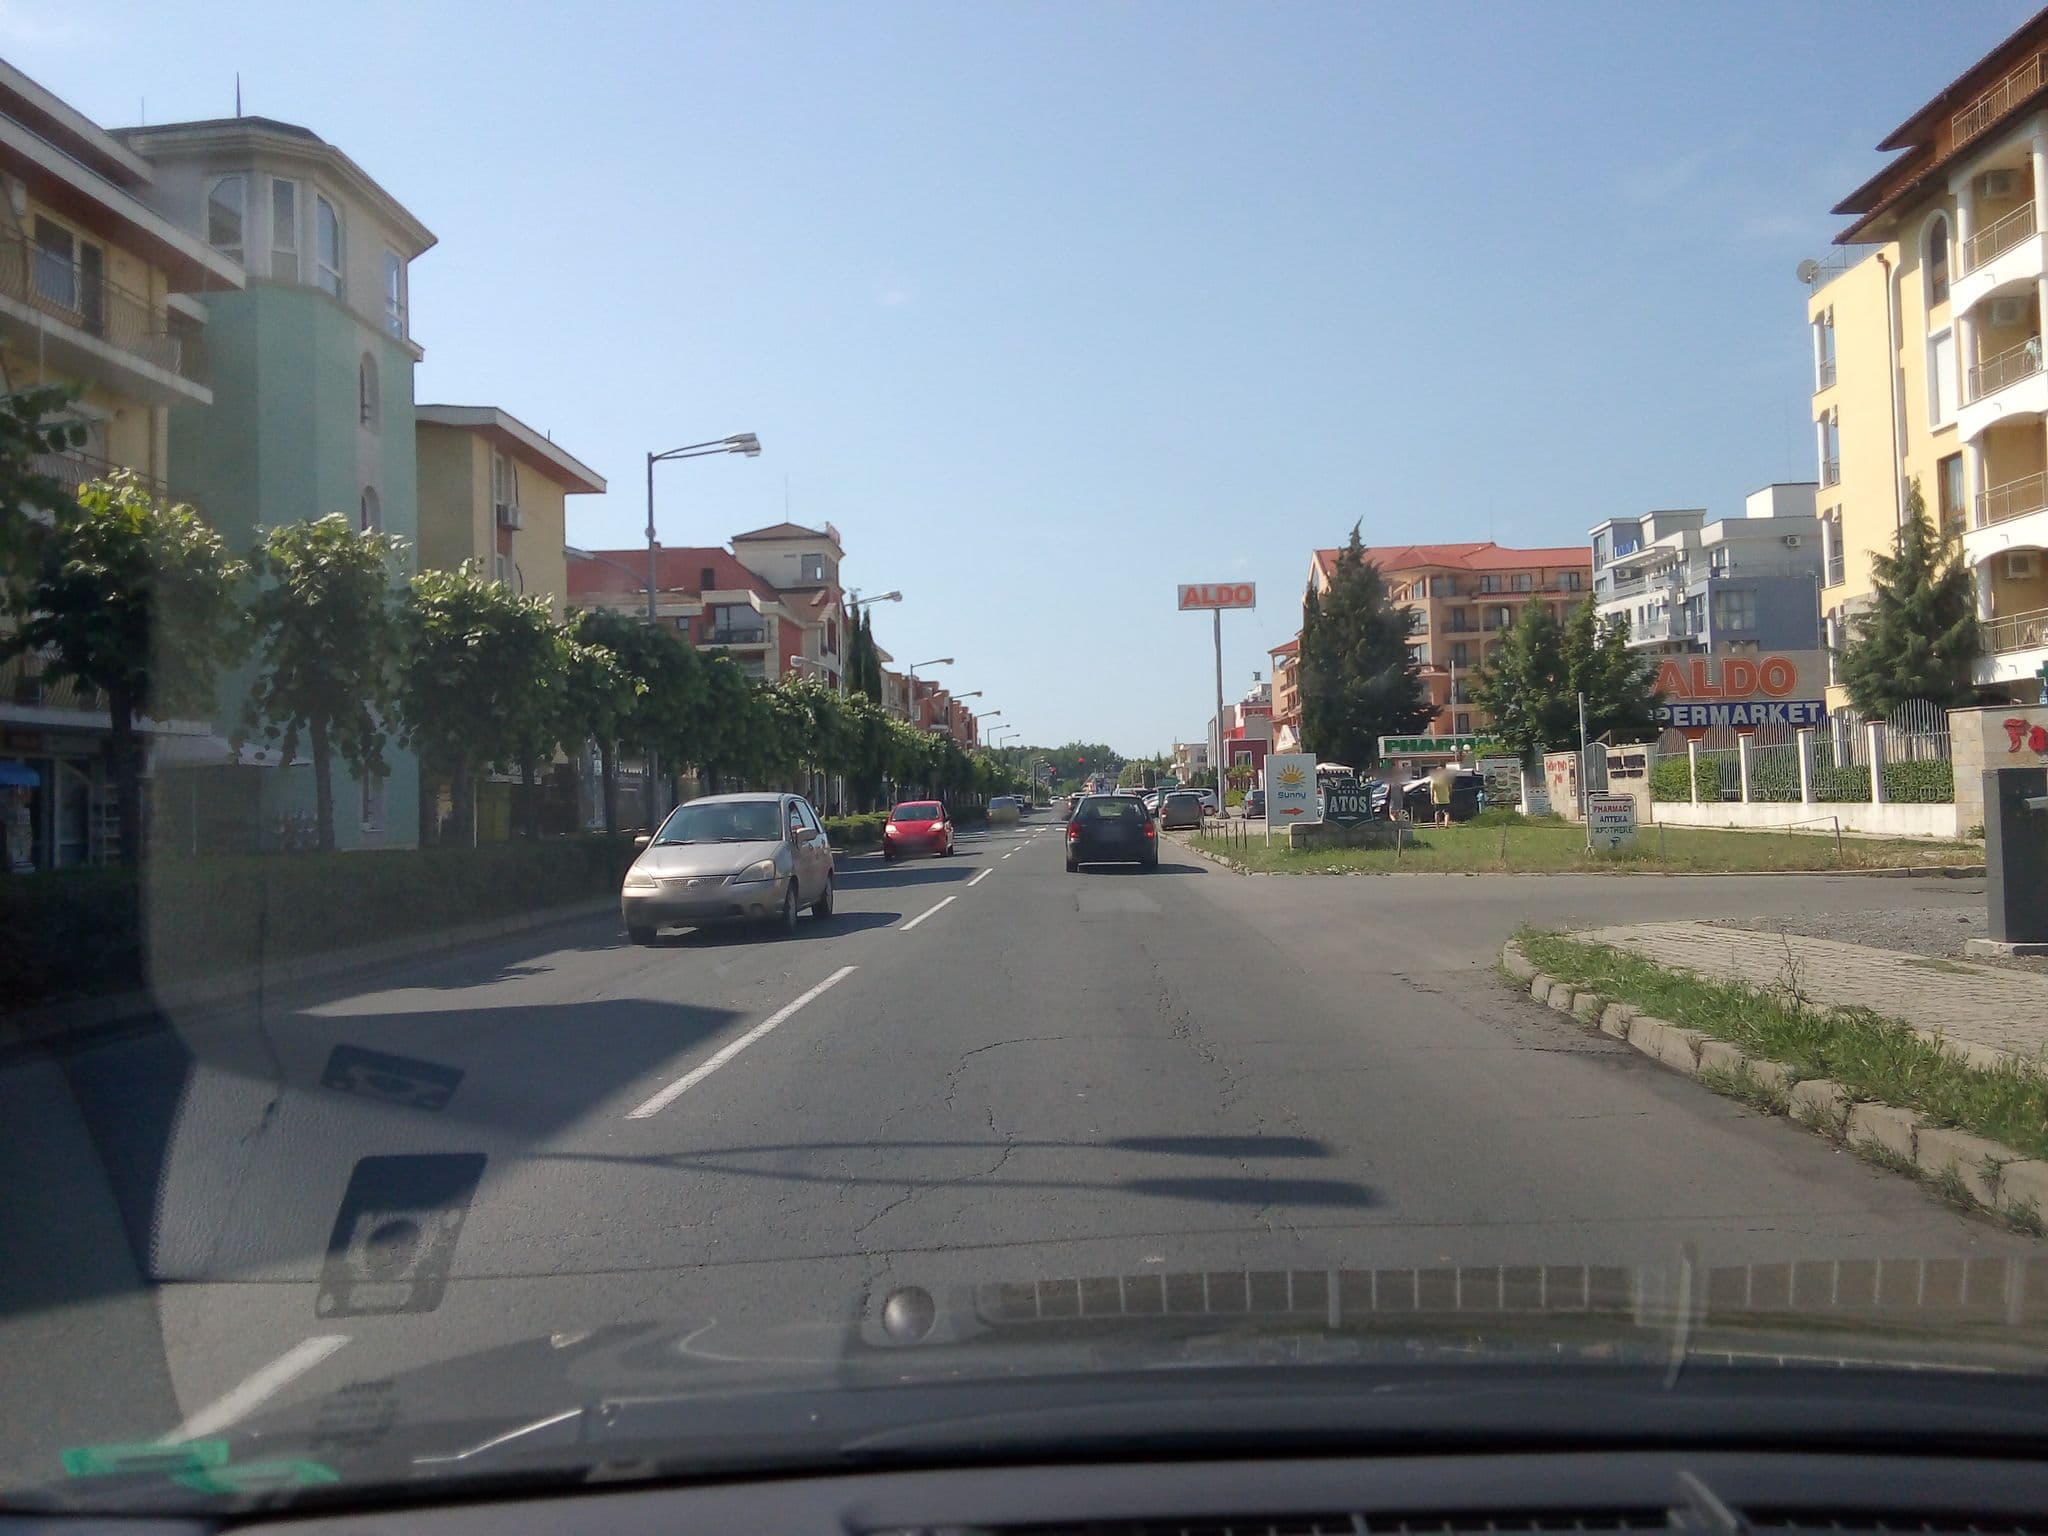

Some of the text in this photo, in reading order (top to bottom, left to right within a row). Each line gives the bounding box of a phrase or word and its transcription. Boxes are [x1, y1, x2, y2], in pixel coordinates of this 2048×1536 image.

[1183, 585, 1253, 607] ALDO
[1653, 656, 1797, 699] ALDO
[1648, 703, 1821, 727] PERMARKET
[1278, 791, 1306, 800] Sunny
[1329, 796, 1368, 814] ATOS
[1593, 804, 1633, 813] PHARMACY
[1599, 815, 1628, 823] АПТЕКА
